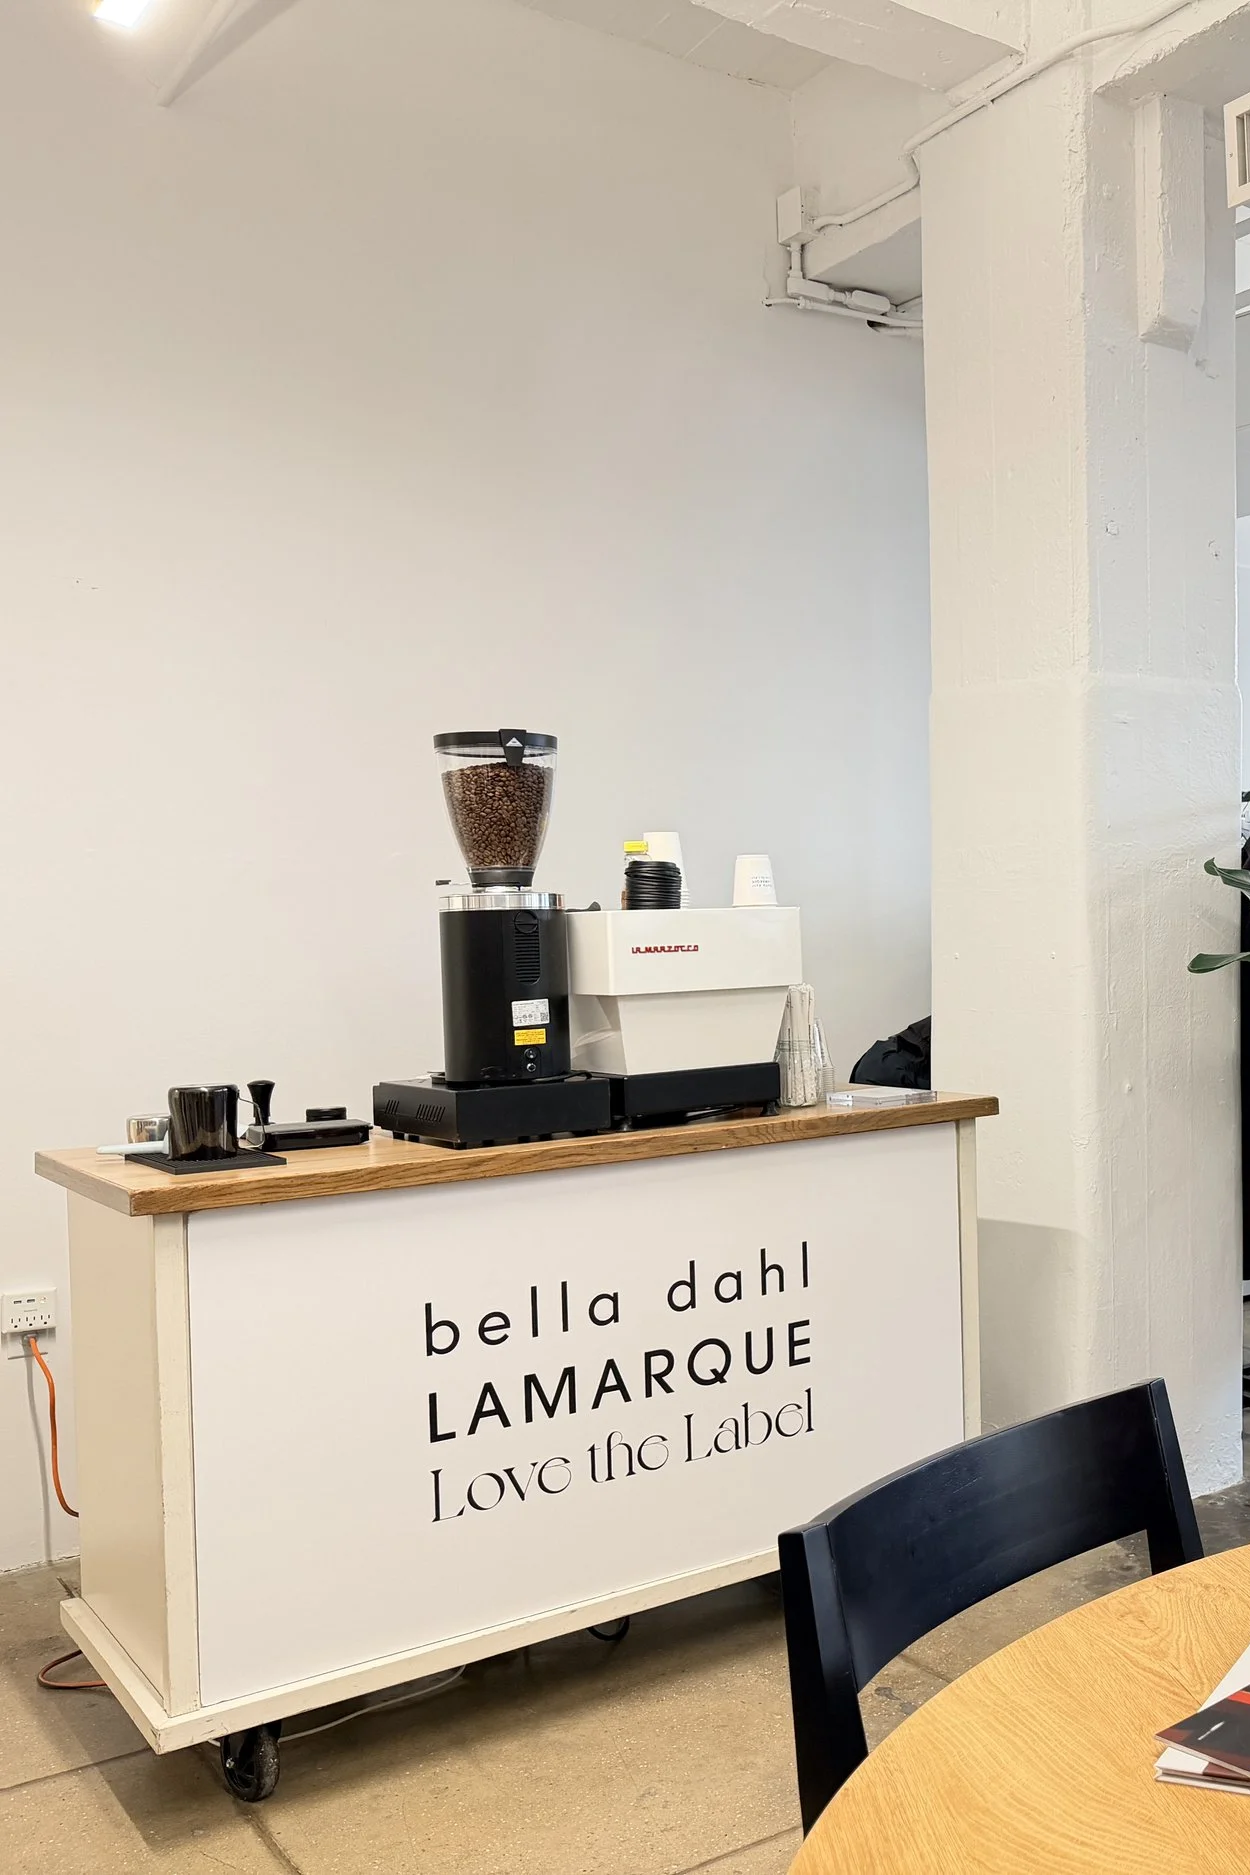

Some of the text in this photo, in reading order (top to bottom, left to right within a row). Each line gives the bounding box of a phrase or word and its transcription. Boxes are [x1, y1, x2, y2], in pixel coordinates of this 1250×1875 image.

[425, 1240, 810, 1358] bella dahl
[428, 1318, 812, 1444] LAMARQUE
[431, 1386, 816, 1524] Love the Label
